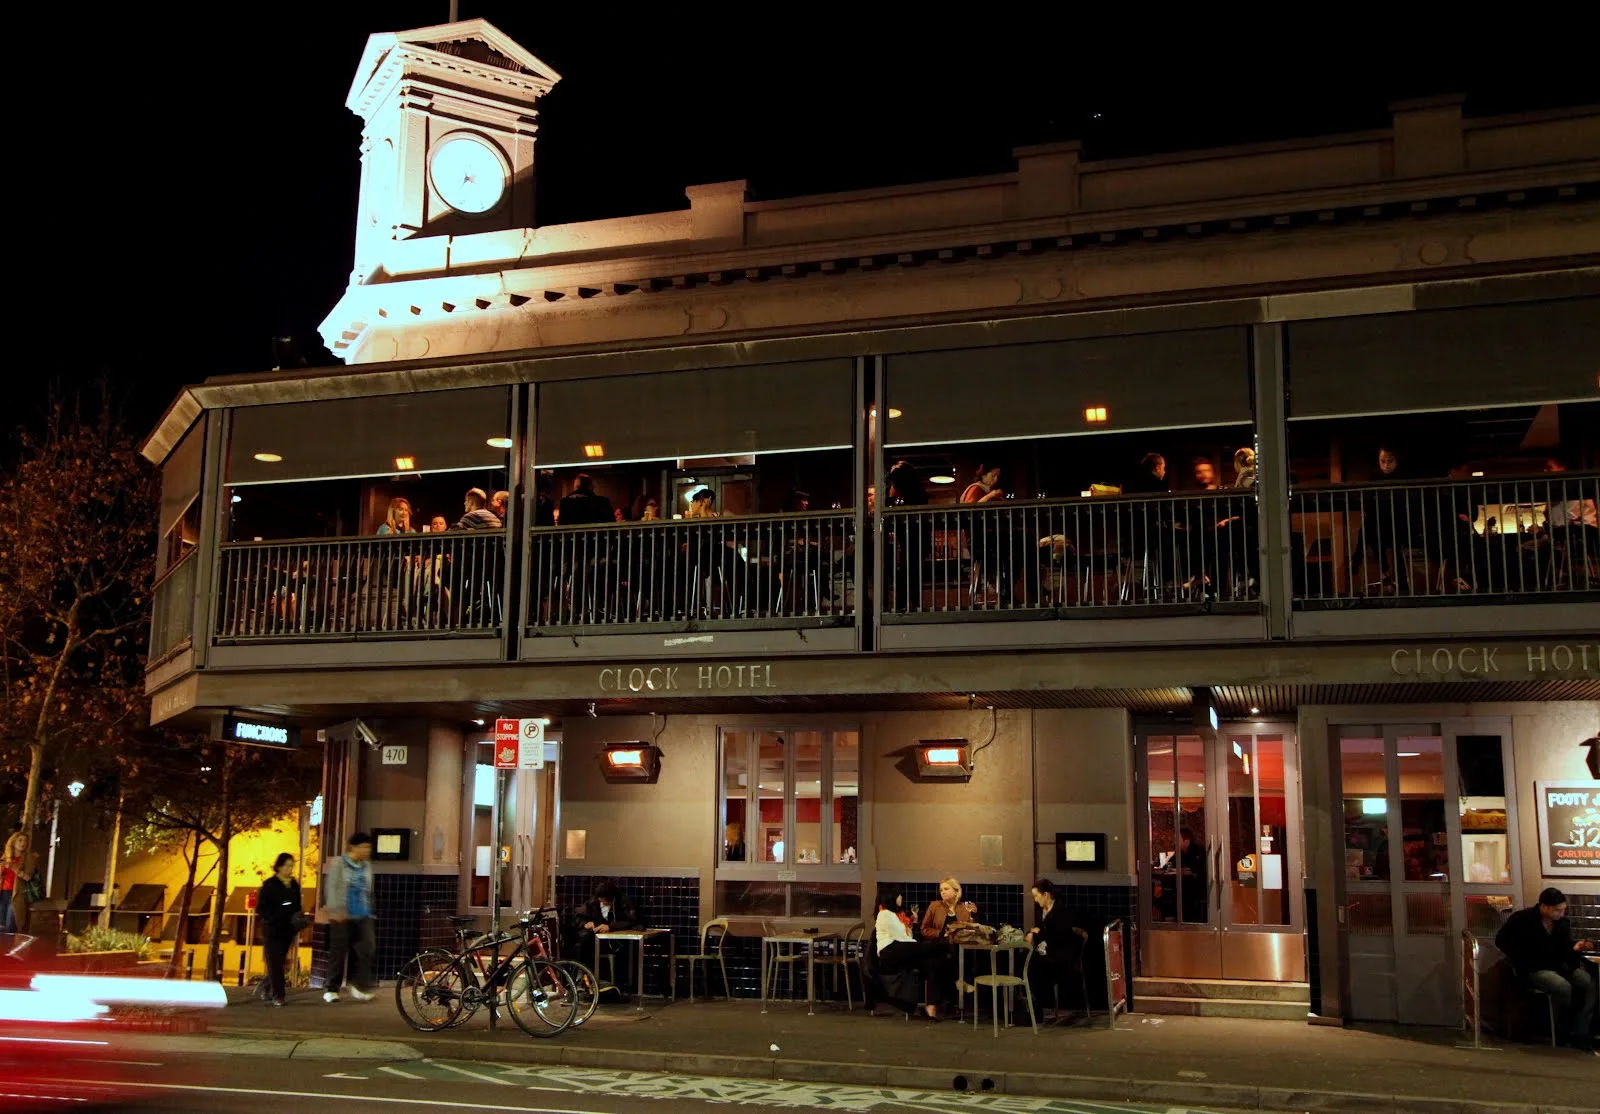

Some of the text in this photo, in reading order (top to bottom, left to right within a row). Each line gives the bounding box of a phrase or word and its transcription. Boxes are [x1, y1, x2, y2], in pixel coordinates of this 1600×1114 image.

[1391, 644, 1600, 675] CLOCK HOT
[599, 665, 777, 692] CLOCK HOTEL
[236, 722, 287, 744] FUNCTIONS
[502, 723, 513, 731] NO
[385, 748, 405, 761] 470
[1547, 792, 1589, 808] FOOTY
[1557, 849, 1594, 859] CARLTON
[526, 1067, 704, 1084] CAR
[720, 1081, 1037, 1110] SHARE
[610, 1083, 869, 1105] ONLY
